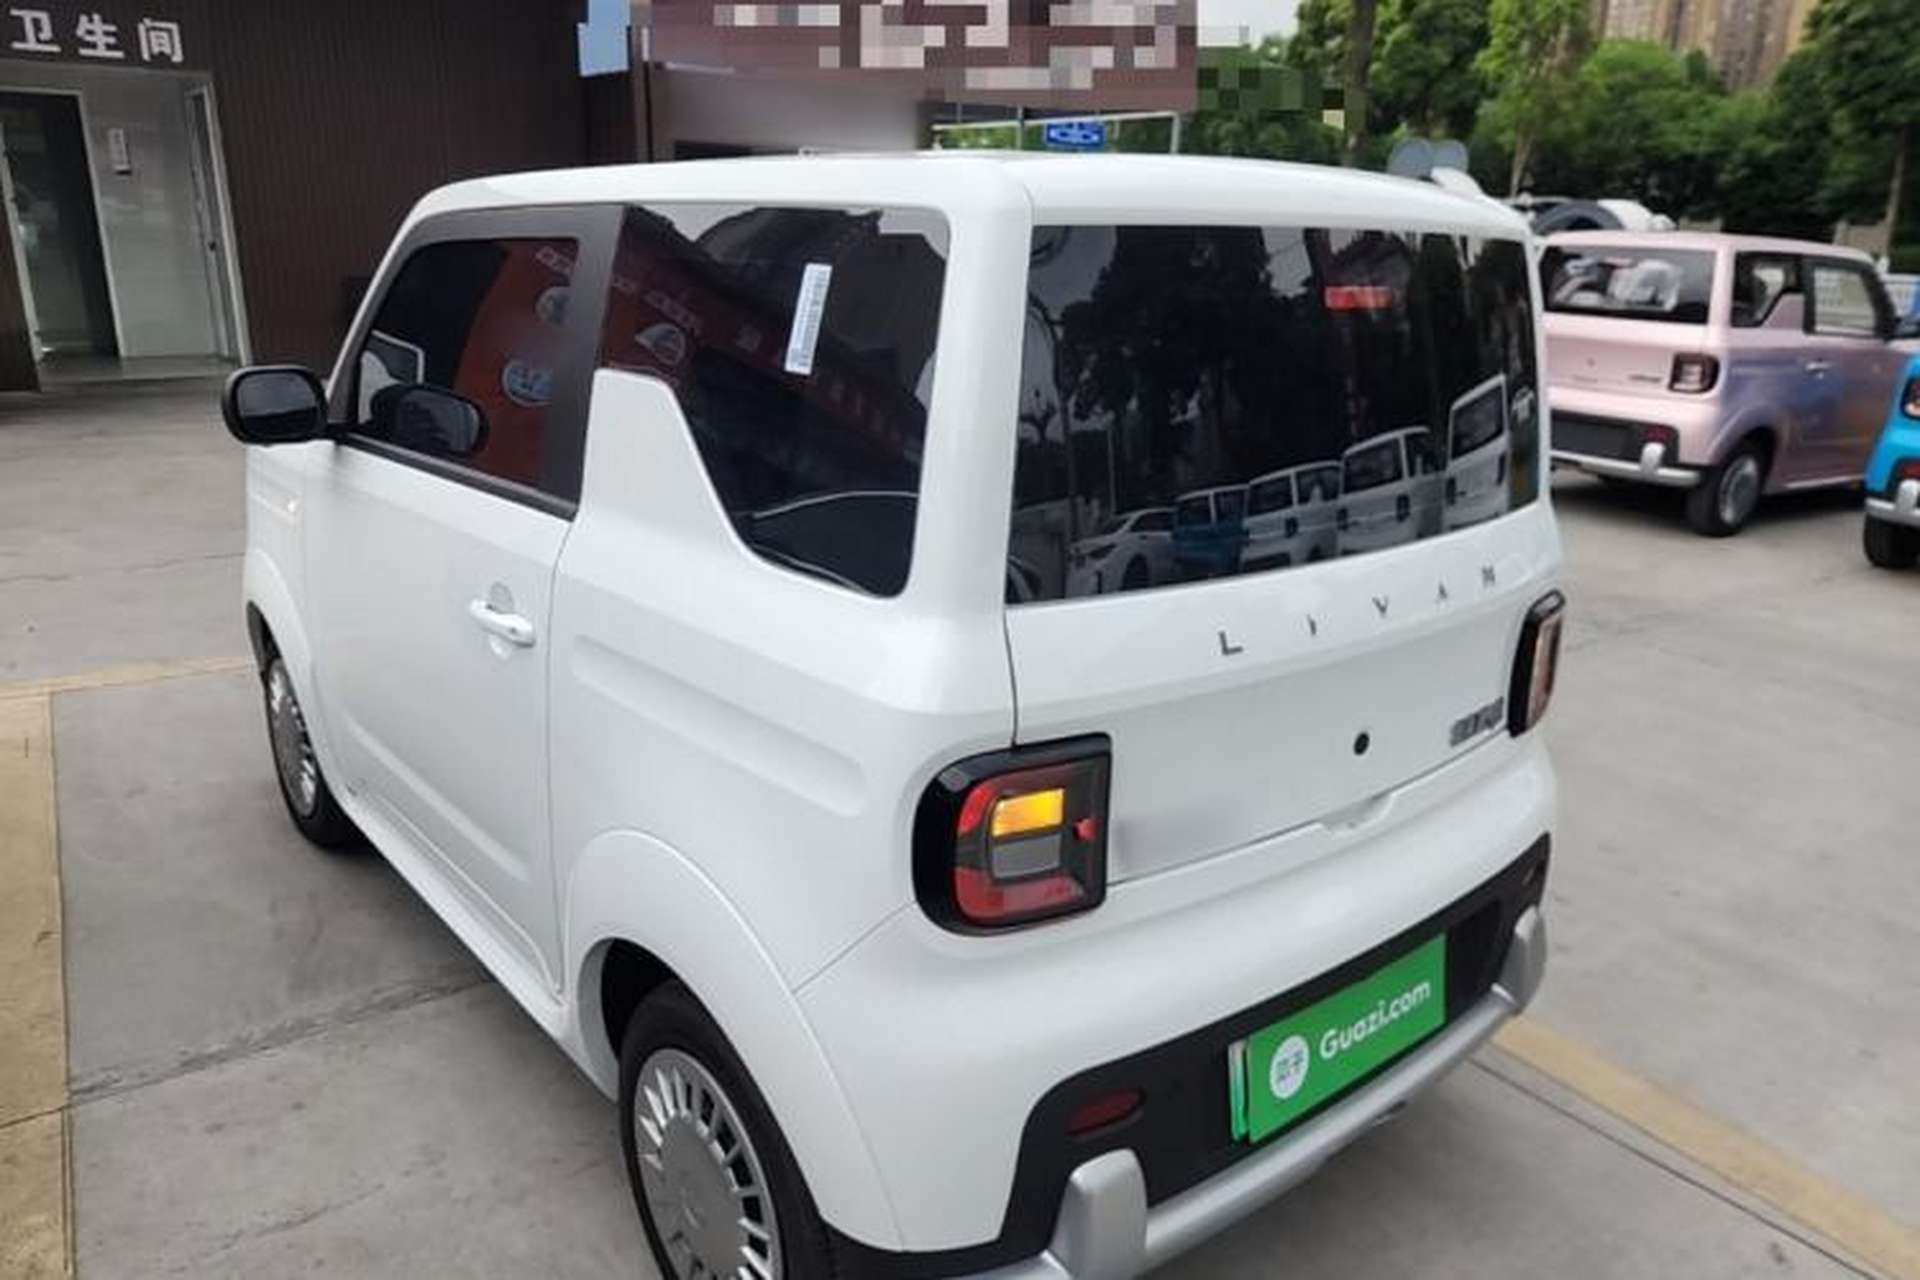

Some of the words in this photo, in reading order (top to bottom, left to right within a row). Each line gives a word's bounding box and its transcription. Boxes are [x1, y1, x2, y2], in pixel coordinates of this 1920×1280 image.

[10, 9, 183, 63] 卫生间
[1319, 982, 1431, 1060] Guazi.com
